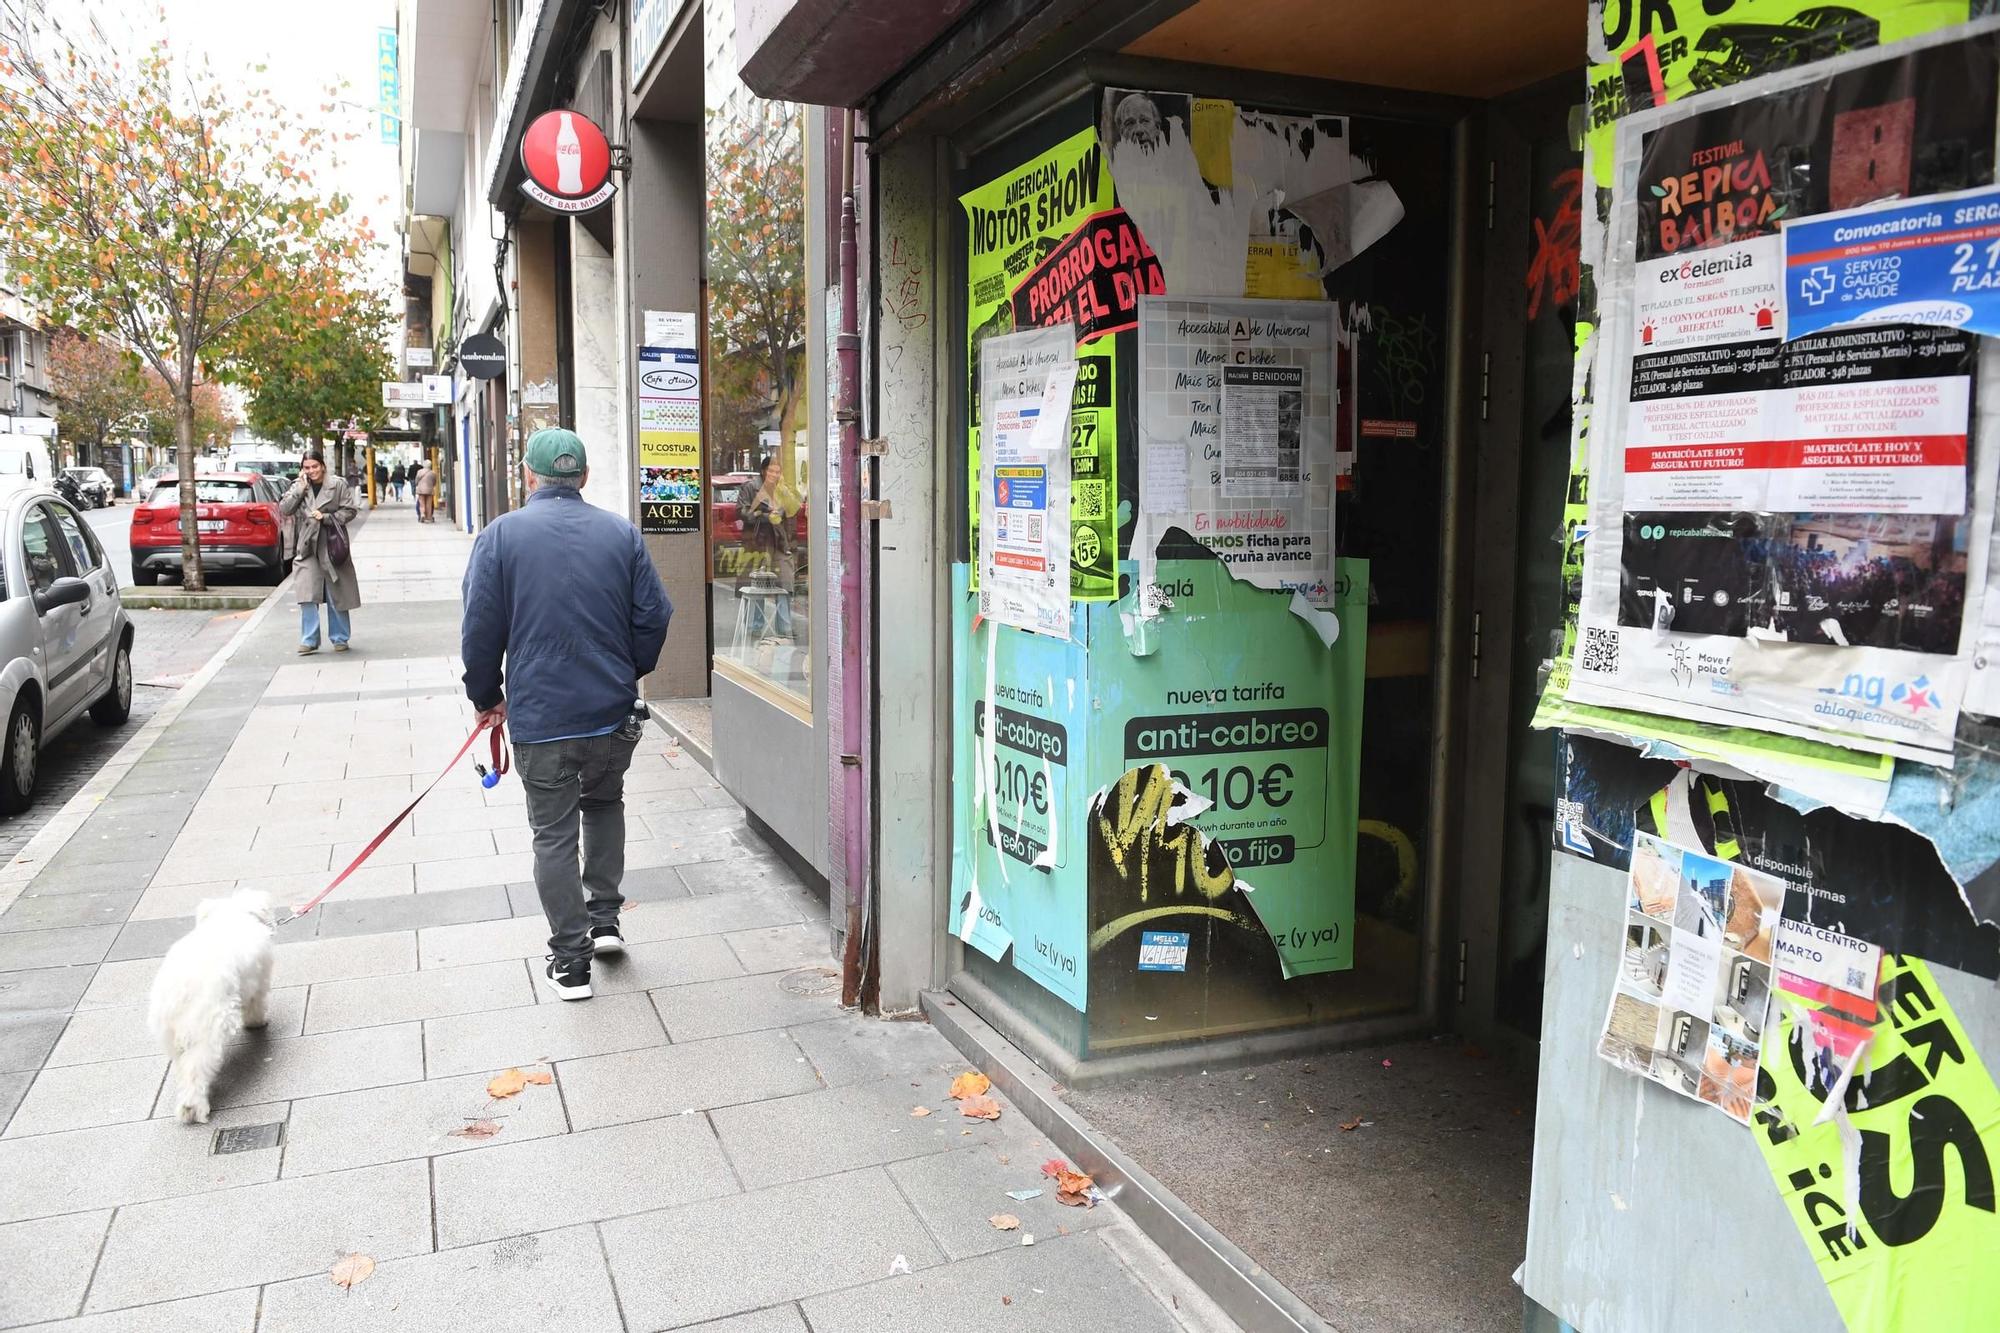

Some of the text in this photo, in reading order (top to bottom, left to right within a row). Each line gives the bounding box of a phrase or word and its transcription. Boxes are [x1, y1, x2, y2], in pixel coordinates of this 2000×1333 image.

[1692, 140, 1744, 166] FESTIVAL
[1005, 160, 1058, 208] AMERICAN
[1661, 150, 1772, 216] REPICA
[531, 186, 608, 210] CAFE BAR MININ
[971, 142, 1102, 256] MOTOR SHOW
[1660, 186, 1781, 252] BALBOA
[1834, 212, 1942, 243] Convocatoria
[1004, 240, 1034, 271] MONSTER
[1008, 256, 1029, 279] TRUCK
[1845, 256, 1901, 275] SERVIZO
[1842, 269, 1900, 289] GALEGO
[1641, 283, 1775, 312] TU PLAZA EN EL SERGAS TE ESPERA
[1841, 281, 1898, 301] de SAÚDE
[1078, 279, 1110, 326] EL
[1669, 305, 1745, 323] CONVOCATORIA
[1266, 319, 1311, 338] Universal
[1677, 320, 1724, 334] ABIERTA!!
[1655, 338, 1685, 348] Comienza
[1792, 340, 1828, 351] AUXILIAR
[1829, 329, 1905, 350] ADMINISTRATIVO
[1912, 330, 1930, 340] 200
[461, 352, 505, 361] sanbrandan
[1035, 349, 1060, 367] Universal
[1195, 348, 1226, 365] Menos
[1640, 344, 1775, 370] AUXILIAR ADMINISTRATIVO 200 plazas
[1791, 341, 1965, 367] PSX (Persoal de Servicios Xerais) 236 plazas
[1252, 372, 1300, 381] BENIDORM
[1682, 358, 1779, 377] Servicios Xerais) 236 plazas
[1790, 365, 1872, 381] CELADOR 348 plazas
[1175, 372, 1202, 390] Máis
[1639, 380, 1703, 394] CELADOR 348 plazas
[1707, 396, 1757, 408] APROBADOS
[1799, 384, 1938, 401] MÁS DEL DE APROBADOS
[1192, 400, 1212, 413] Tren
[1795, 396, 1940, 412] PROFESORES ESPECIALIZADOS
[1643, 407, 1758, 423] PROFESORES ESPECIALIZADOS
[1804, 409, 1924, 423] MATERIAL ACTUALIZADO
[1190, 420, 1217, 437] Máis
[1651, 419, 1746, 432] MATERIAL ACTUALIZADO
[1832, 421, 1898, 433] TEST ONLINE
[1072, 424, 1096, 448] 27
[1675, 432, 1692, 441] TEST
[1693, 430, 1725, 440] ONLINE
[642, 443, 697, 452] TU COSTURA
[1715, 448, 1736, 457] HOY
[1884, 442, 1910, 452] HOY
[1913, 442, 1923, 451] Y
[1650, 458, 1744, 469] ASEGURA TU FUTURO!
[1802, 452, 1923, 465] ASEGURA TU FUTURO!
[647, 504, 694, 518] ACRE
[1194, 509, 1288, 531] En mobilidade
[1247, 534, 1279, 548] ficha
[1283, 535, 1311, 550] para
[1267, 552, 1312, 562] avance
[1699, 653, 1723, 665] Move
[1698, 664, 1718, 675] pola
[1017, 687, 1043, 709] tarifa
[1167, 683, 1285, 705] nueva tarifa
[1843, 672, 1886, 708] ng
[978, 711, 1062, 757] ati-cabreo
[1137, 718, 1318, 752] anti-cabreo
[1219, 817, 1287, 832] durante un año
[1250, 842, 1282, 865] fijo
[1754, 854, 1814, 879] disponible
[1785, 877, 1847, 905] ataformas
[1153, 935, 1179, 943] HELLO
[1291, 922, 1339, 949] (y ya)
[1816, 930, 1869, 954] CENTRO
[1034, 934, 1077, 977] luz (y ya)
[1776, 940, 1824, 964] MARZO
